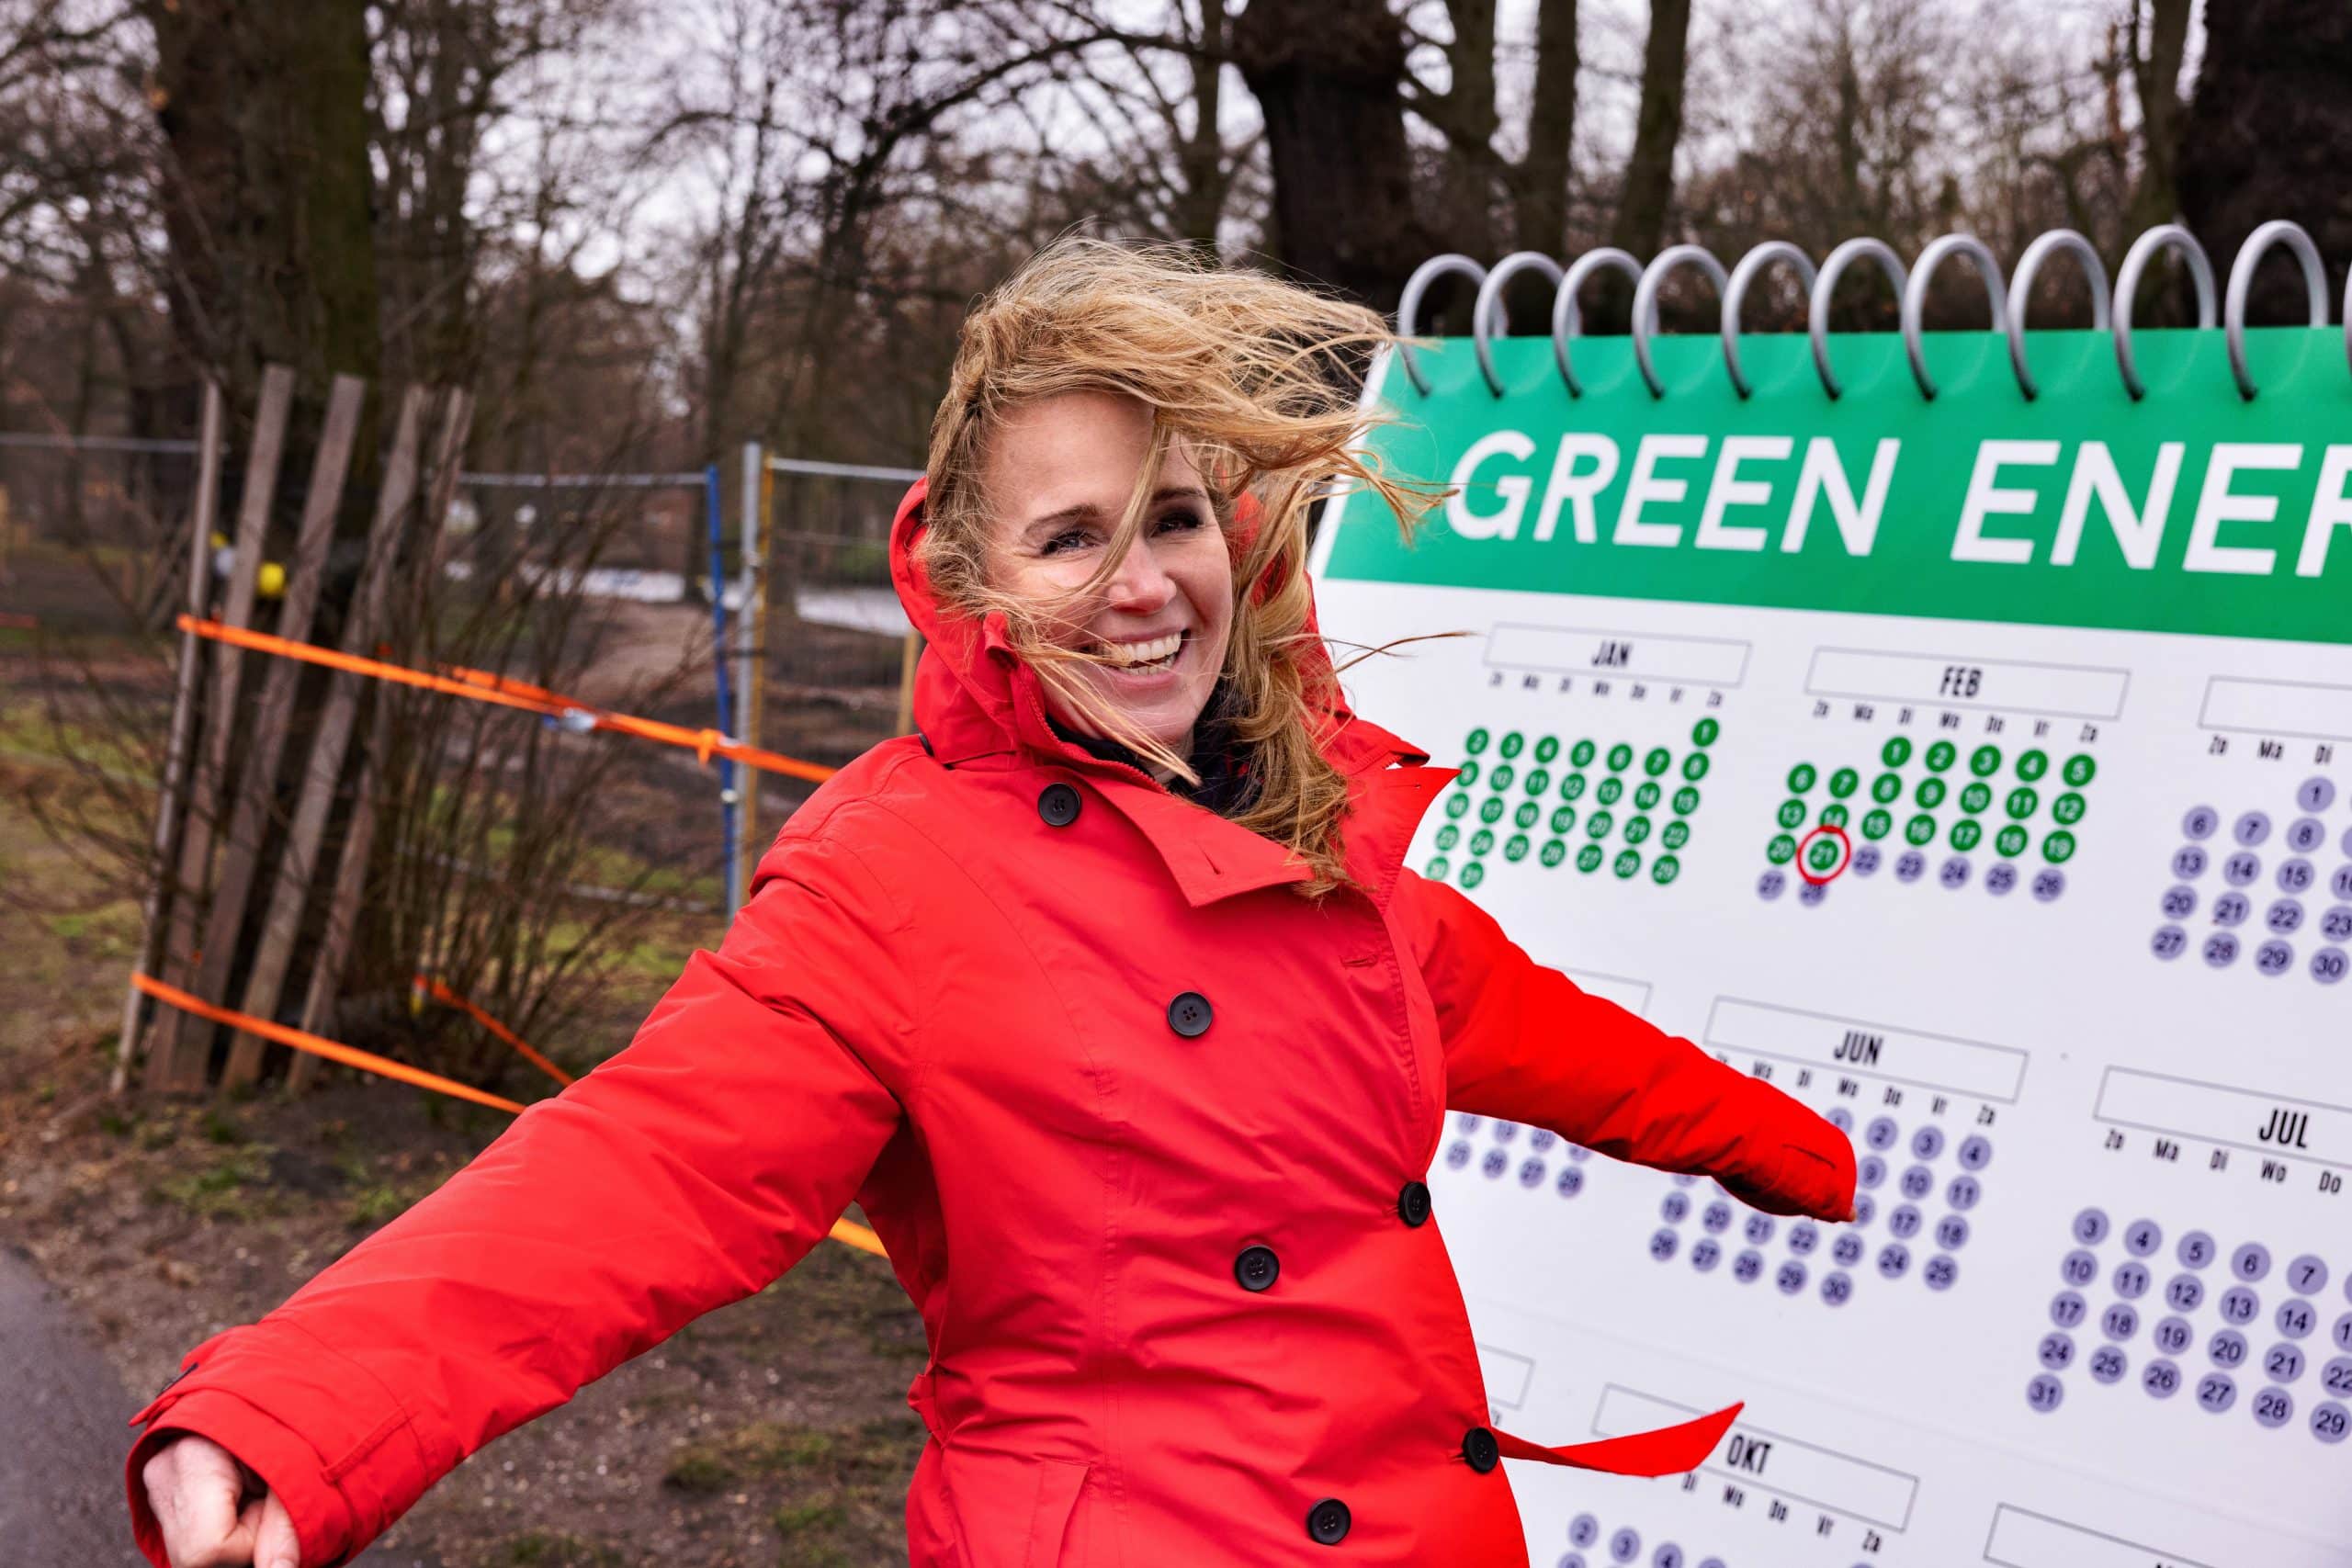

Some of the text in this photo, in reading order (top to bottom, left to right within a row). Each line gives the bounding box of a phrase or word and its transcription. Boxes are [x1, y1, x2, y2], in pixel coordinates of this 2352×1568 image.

[1446, 429, 1902, 557] GREEN
[1591, 642, 1630, 667] JAN
[1939, 666, 1983, 698] FEB
[1892, 743, 2086, 781] 1 2 3 4 5
[1795, 771, 2080, 819] 6 7 8 9 10 11 12
[2312, 785, 2322, 804] 1
[1782, 807, 1802, 825] 13
[1867, 817, 1886, 835] 15
[1911, 822, 1930, 840] 16
[1955, 827, 1976, 843] 17
[2001, 833, 2022, 852] 18
[2049, 839, 2070, 857] 19
[2192, 815, 2313, 846] 6 7 8
[1761, 875, 1782, 893] 27
[1771, 840, 2059, 893] 20 21 22 23 24 25 26
[2177, 853, 2308, 886] 13 14 15
[2165, 893, 2352, 935] 20 21 22 23
[2154, 932, 2343, 977] 27 28 29 30
[1833, 1031, 1883, 1066] JUN
[1872, 1124, 1981, 1162] 2 3 4
[2258, 1109, 2308, 1149] JUL
[2104, 1128, 2343, 1194] Zo Ma Di Wo Do
[1864, 1163, 1974, 1203] 9 10 11
[1666, 1200, 1951, 1282] 19 20 21 22 23 24 25
[1894, 1213, 1963, 1244] 17 18
[1652, 1235, 1849, 1301] 26 27 28 29 30
[2083, 1217, 2316, 1286] 3 4 5 6 7
[2069, 1258, 2308, 1332] 10 11 12 13 14
[2058, 1300, 2082, 1321] 17
[2109, 1312, 2133, 1336] 18
[2163, 1325, 2187, 1348] 19
[2214, 1337, 2242, 1362] 20
[2271, 1352, 2297, 1376] 21
[2031, 1382, 2057, 1404] 31
[2043, 1339, 2345, 1435] 24 25 26 27 28 29
[1726, 1434, 1772, 1474] OKT
[1576, 1522, 1590, 1542] 2
[1618, 1537, 1633, 1557] 3
